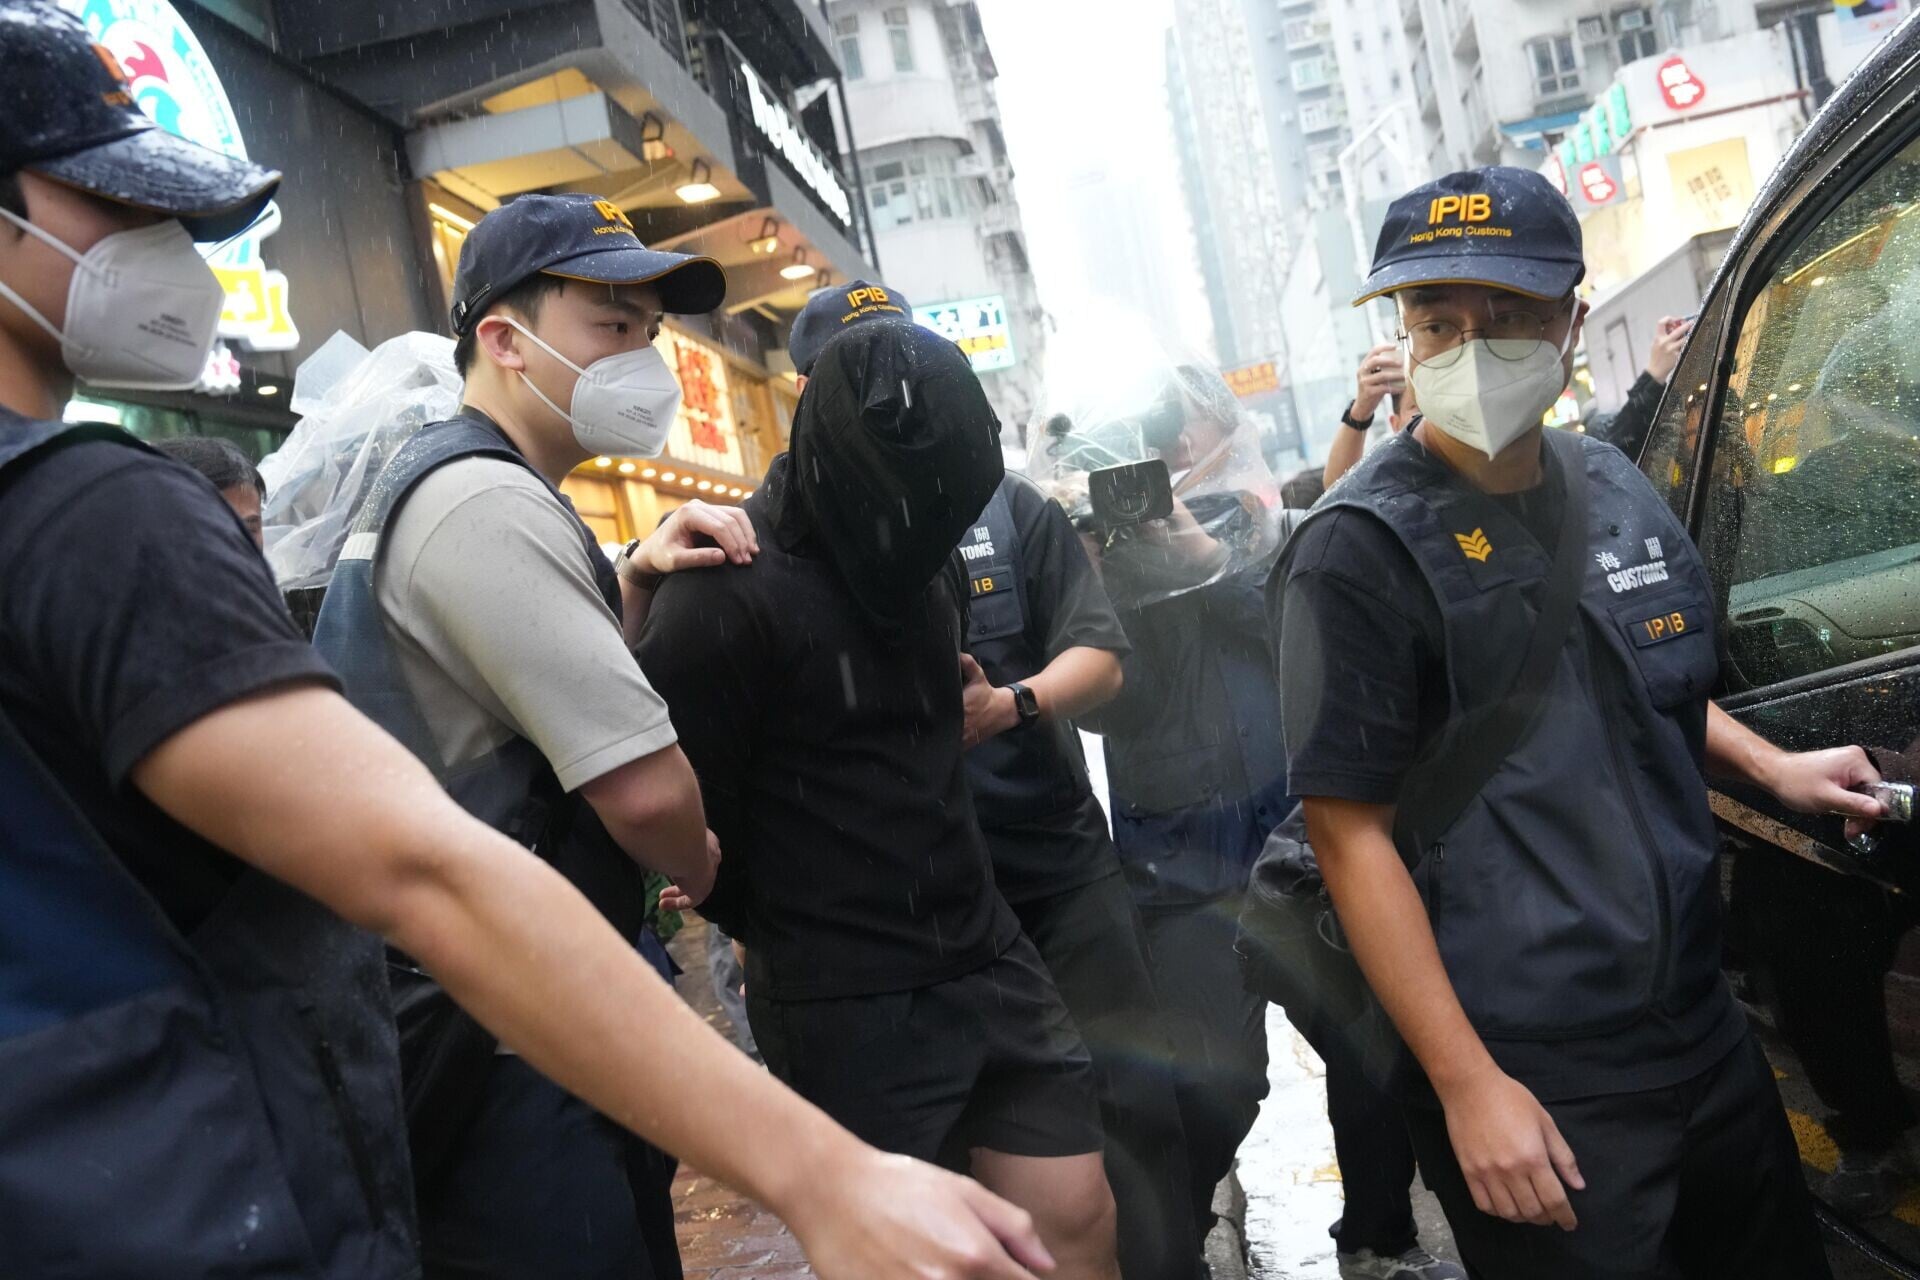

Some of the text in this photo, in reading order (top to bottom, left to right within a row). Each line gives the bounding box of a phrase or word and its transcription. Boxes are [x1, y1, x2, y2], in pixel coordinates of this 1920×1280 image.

[1428, 194, 1491, 225] IPIB
[1410, 226, 1512, 244] Hong Kong Customs
[847, 286, 889, 308] IPIB
[841, 311, 860, 324] Hong
[859, 304, 878, 315] Kong
[1607, 560, 1669, 593] CUSTOMS
[1645, 612, 1685, 640] IPIB
